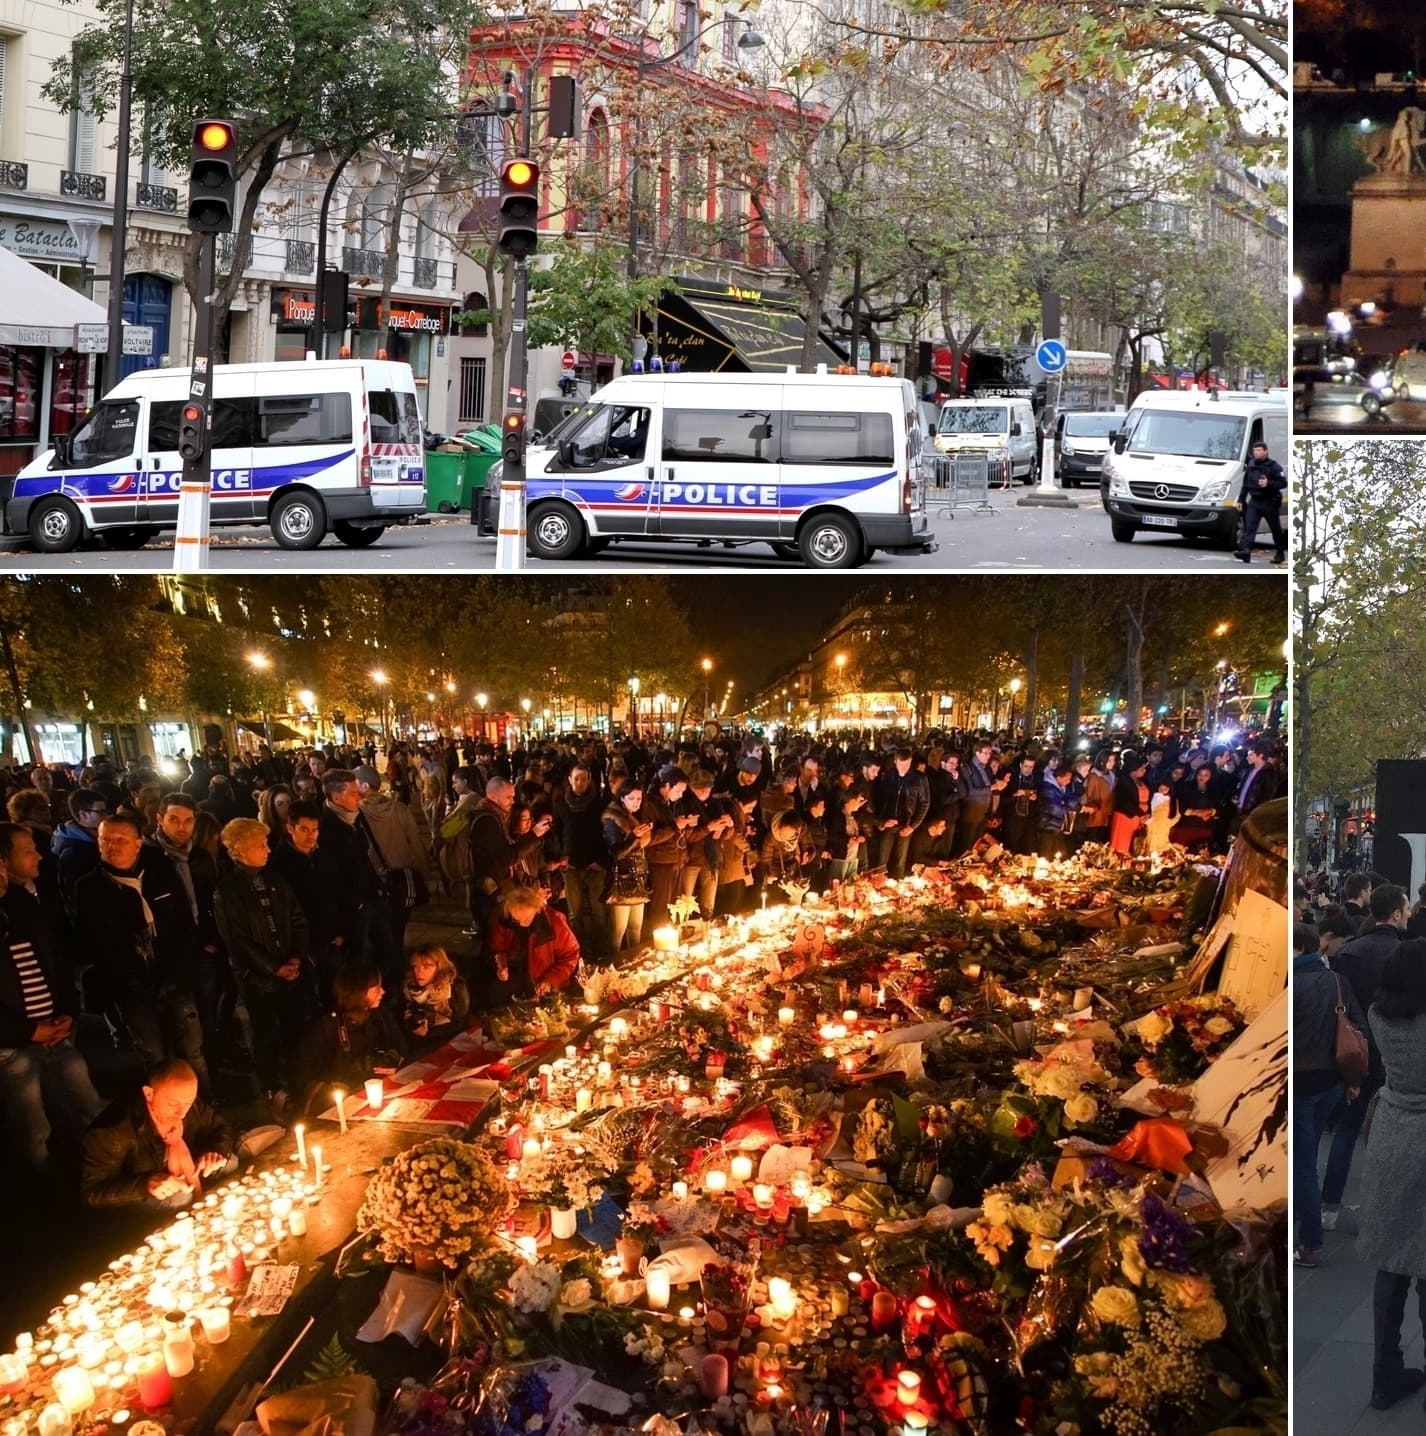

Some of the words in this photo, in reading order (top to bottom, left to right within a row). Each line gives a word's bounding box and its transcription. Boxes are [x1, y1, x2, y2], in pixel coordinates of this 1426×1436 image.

[289, 298, 316, 324] Parque
[123, 338, 152, 346] VOLTAIRE
[664, 353, 689, 365] Cfé
[150, 470, 250, 492] POCE
[663, 484, 778, 506] POLICE
